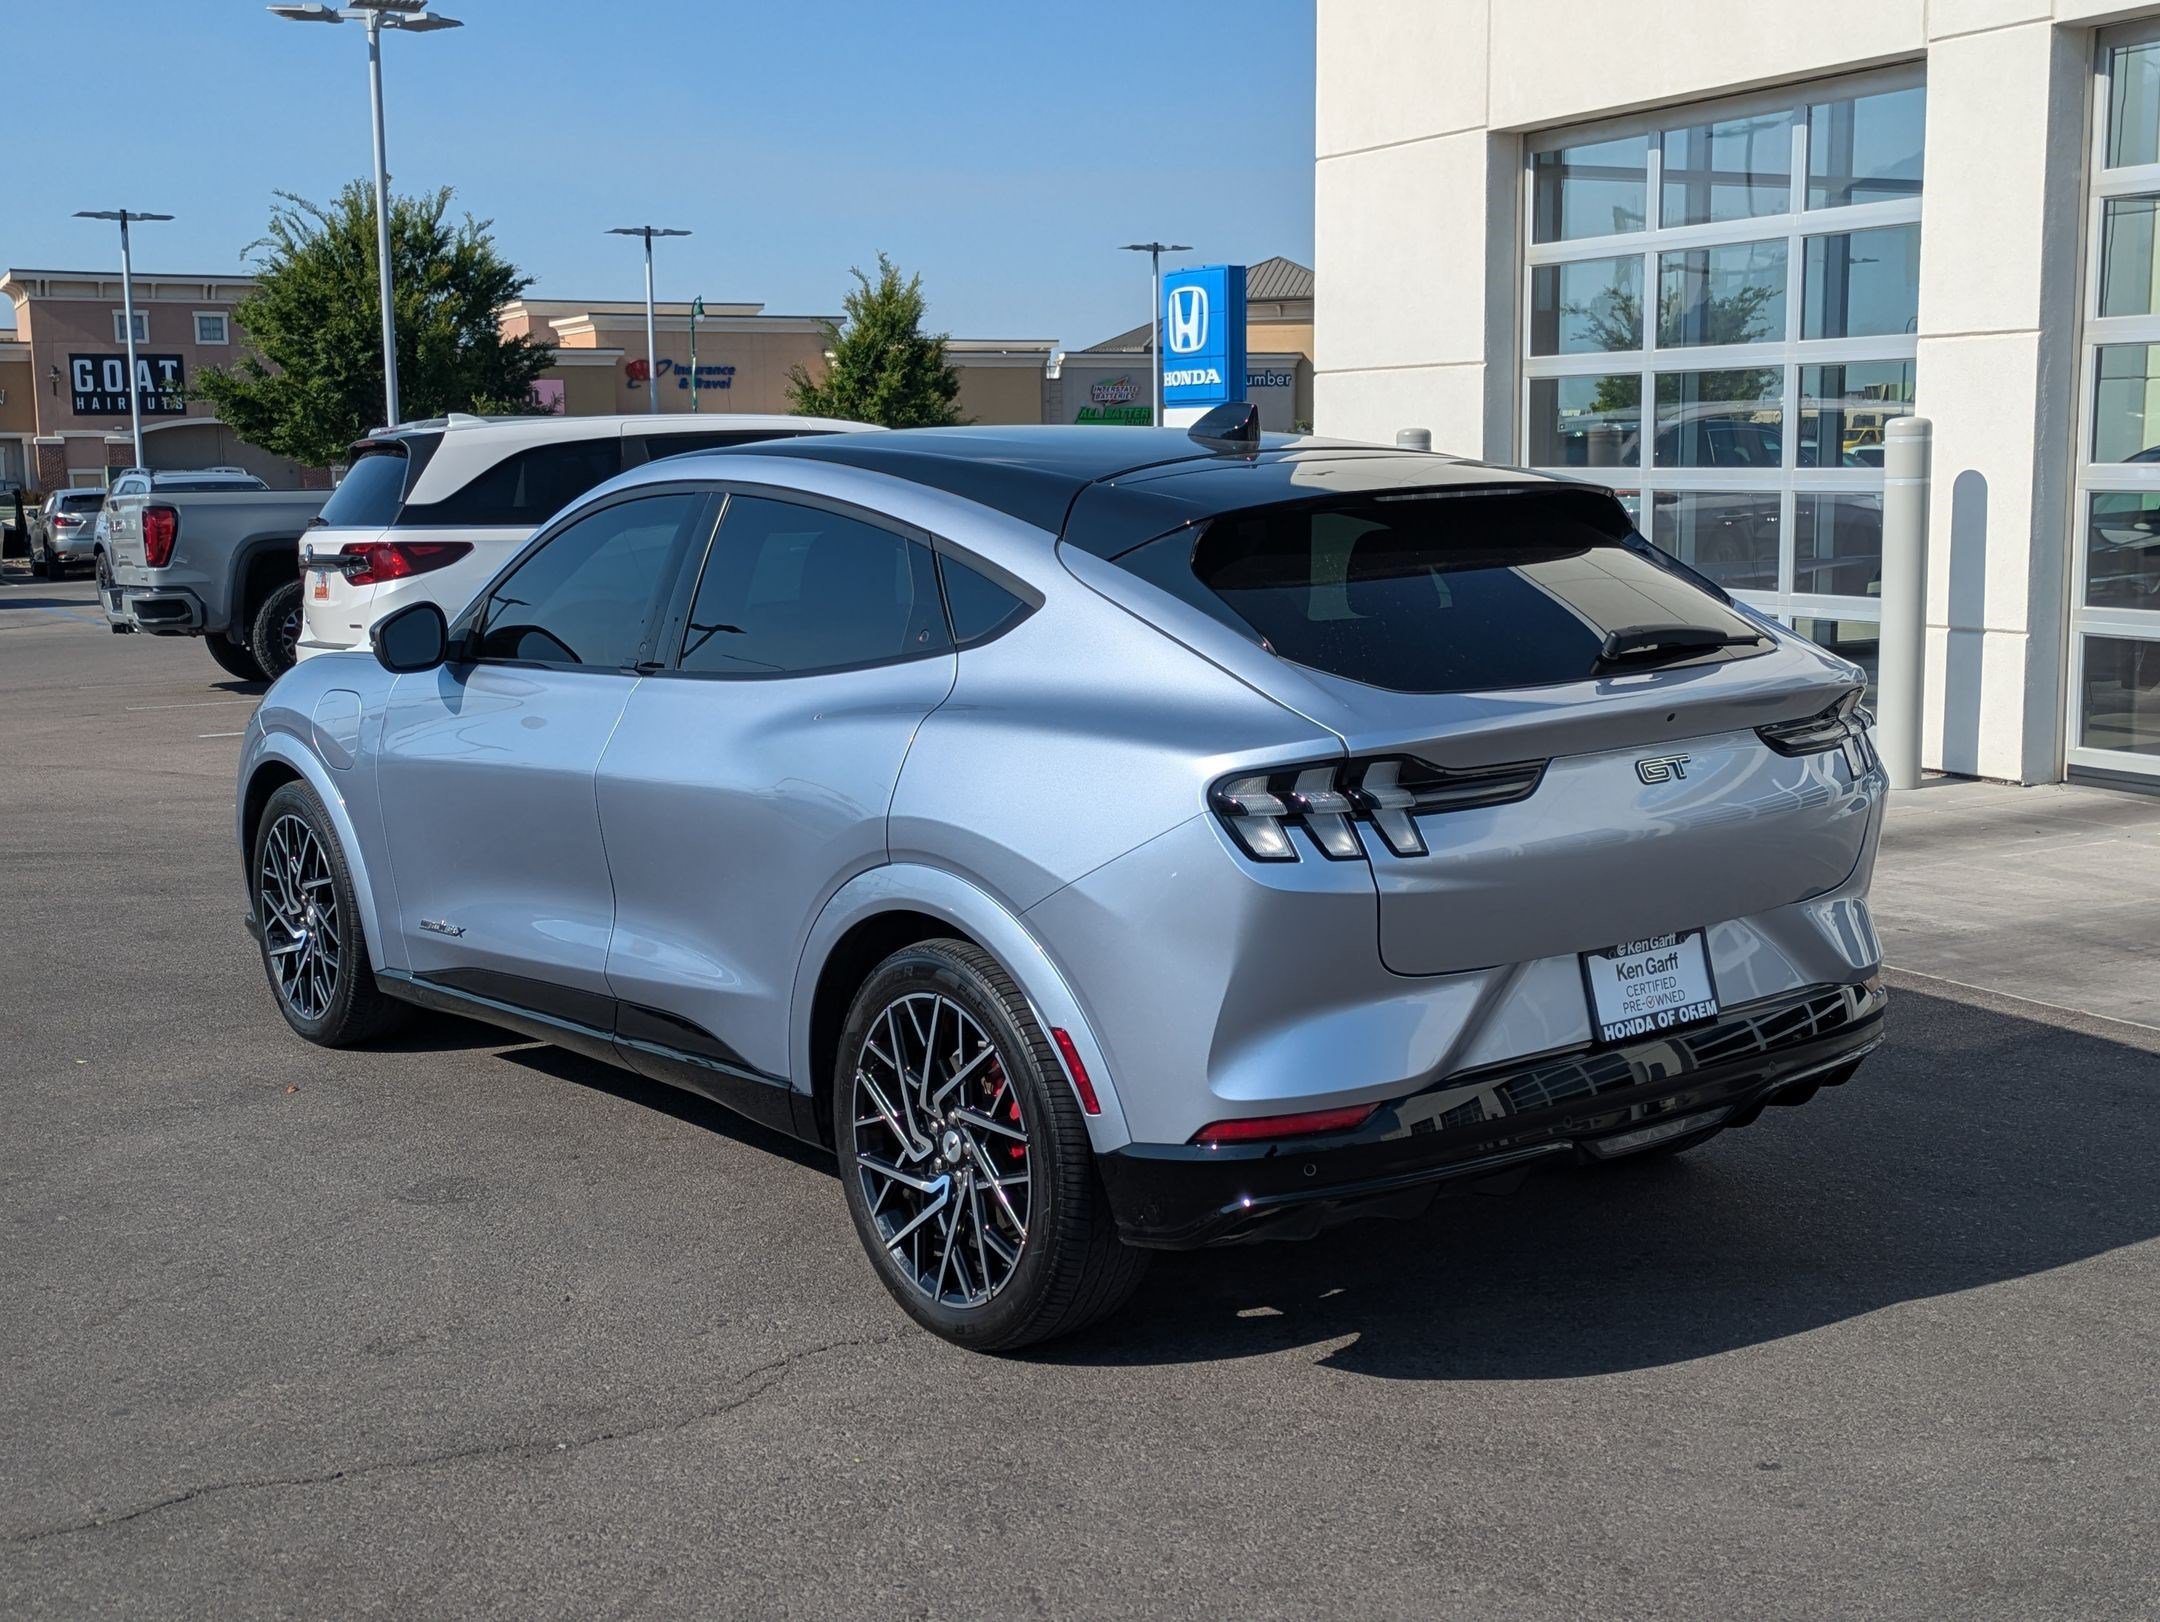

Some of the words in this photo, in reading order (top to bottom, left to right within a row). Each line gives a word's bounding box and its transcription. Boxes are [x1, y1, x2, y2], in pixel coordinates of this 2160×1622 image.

[678, 377, 689, 389] &
[1163, 368, 1222, 388] HONDA
[1246, 370, 1292, 386] umber
[1092, 385, 1139, 394] INTERSTATE
[1093, 392, 1137, 401] BATTERIES
[76, 396, 183, 410] HAIRUTS
[1079, 406, 1100, 418] ALL
[1635, 753, 1691, 785] GT
[1627, 940, 1650, 955] Ken
[1649, 932, 1677, 950] Garff
[1615, 960, 1645, 982] Ken
[1645, 951, 1678, 975] Garff
[1625, 976, 1677, 998] CERTIFIED
[1603, 1017, 1655, 1042] HONDA
[1657, 1009, 1676, 1028] OF
[1678, 1000, 1718, 1023] OREM
